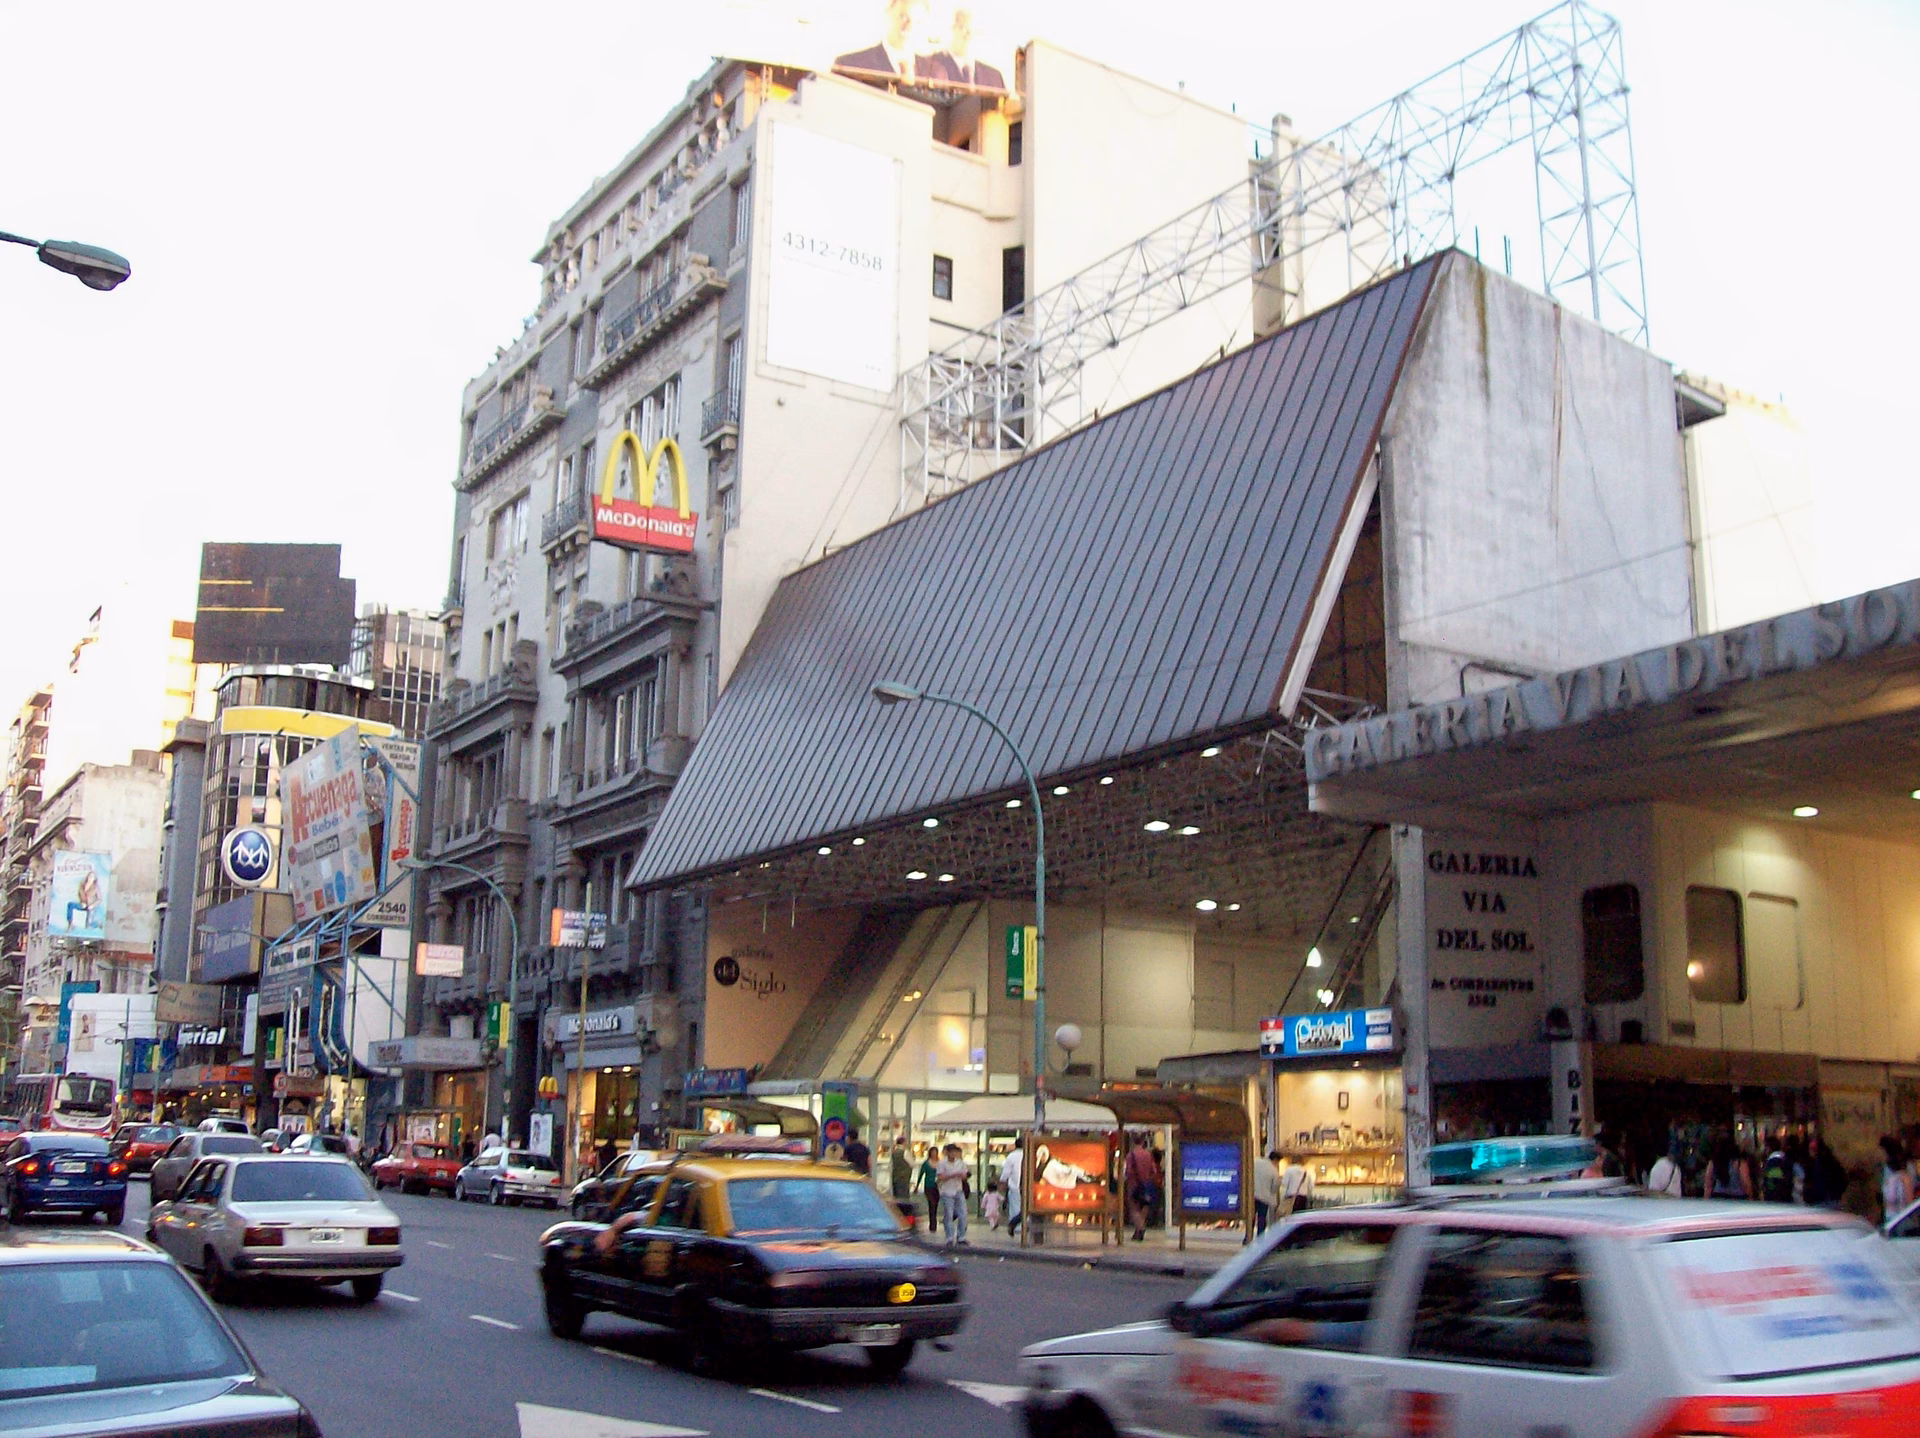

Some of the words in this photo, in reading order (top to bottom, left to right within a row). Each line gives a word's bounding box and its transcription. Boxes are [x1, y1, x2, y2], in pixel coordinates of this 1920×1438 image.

[782, 231, 882, 271] 4312-7858
[596, 507, 696, 538] McDonald's
[1311, 681, 1531, 775] GALERIA
[1545, 655, 1650, 722] VIA
[1665, 618, 1799, 698] DEL
[1810, 581, 1920, 660] SO
[290, 769, 357, 845] Azcuenaga
[1428, 849, 1538, 877] GALERIA
[378, 901, 407, 914] 2540
[1462, 890, 1506, 913] VIA
[1437, 928, 1486, 952] DEL
[1491, 928, 1534, 952] SOL
[741, 971, 786, 1000] Siglo
